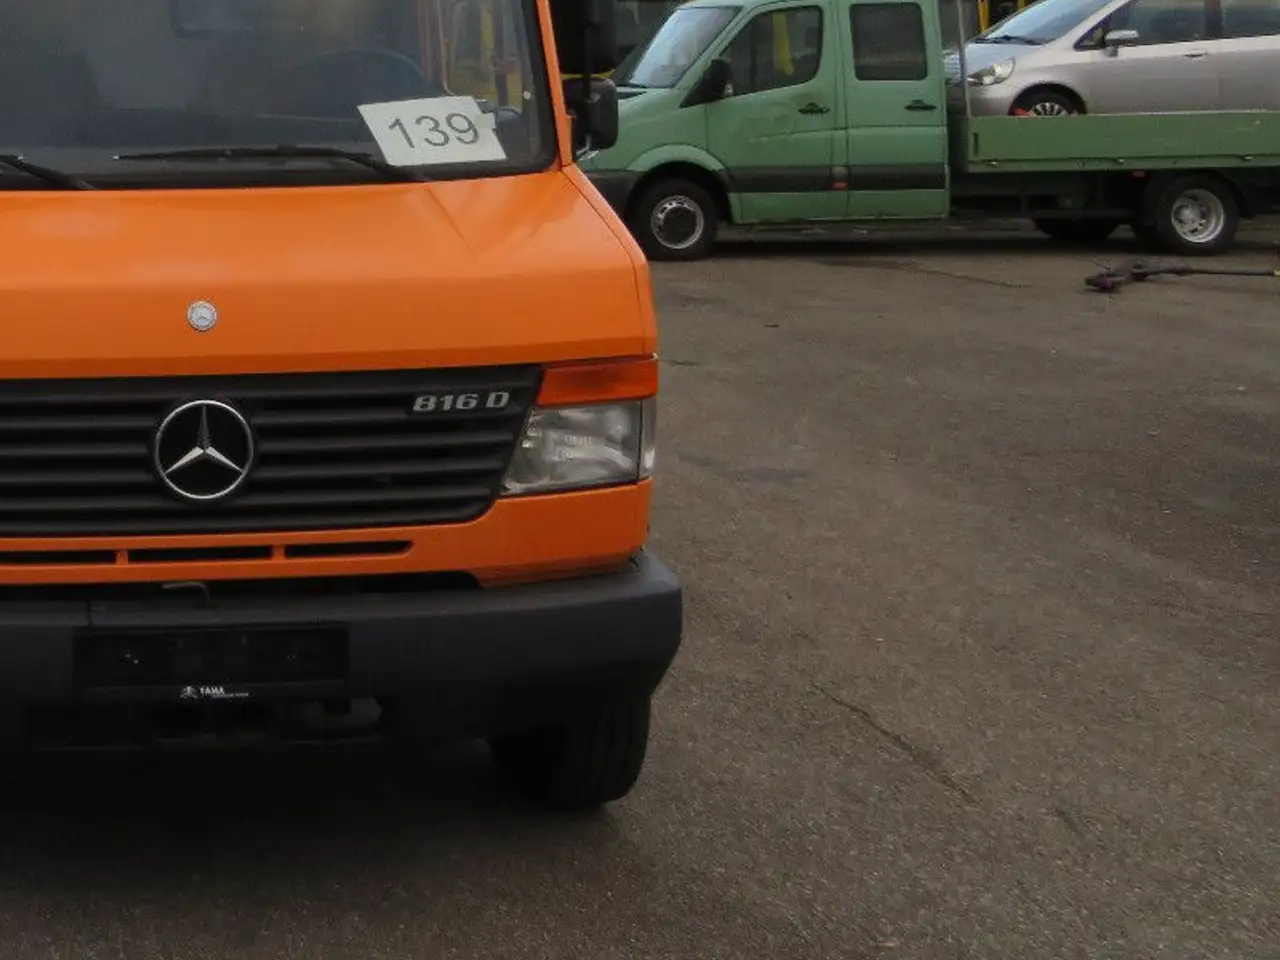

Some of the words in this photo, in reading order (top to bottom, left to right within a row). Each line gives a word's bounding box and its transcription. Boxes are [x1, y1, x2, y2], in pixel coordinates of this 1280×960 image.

[388, 112, 480, 149] 139
[412, 393, 478, 412] 816
[485, 391, 510, 409] D
